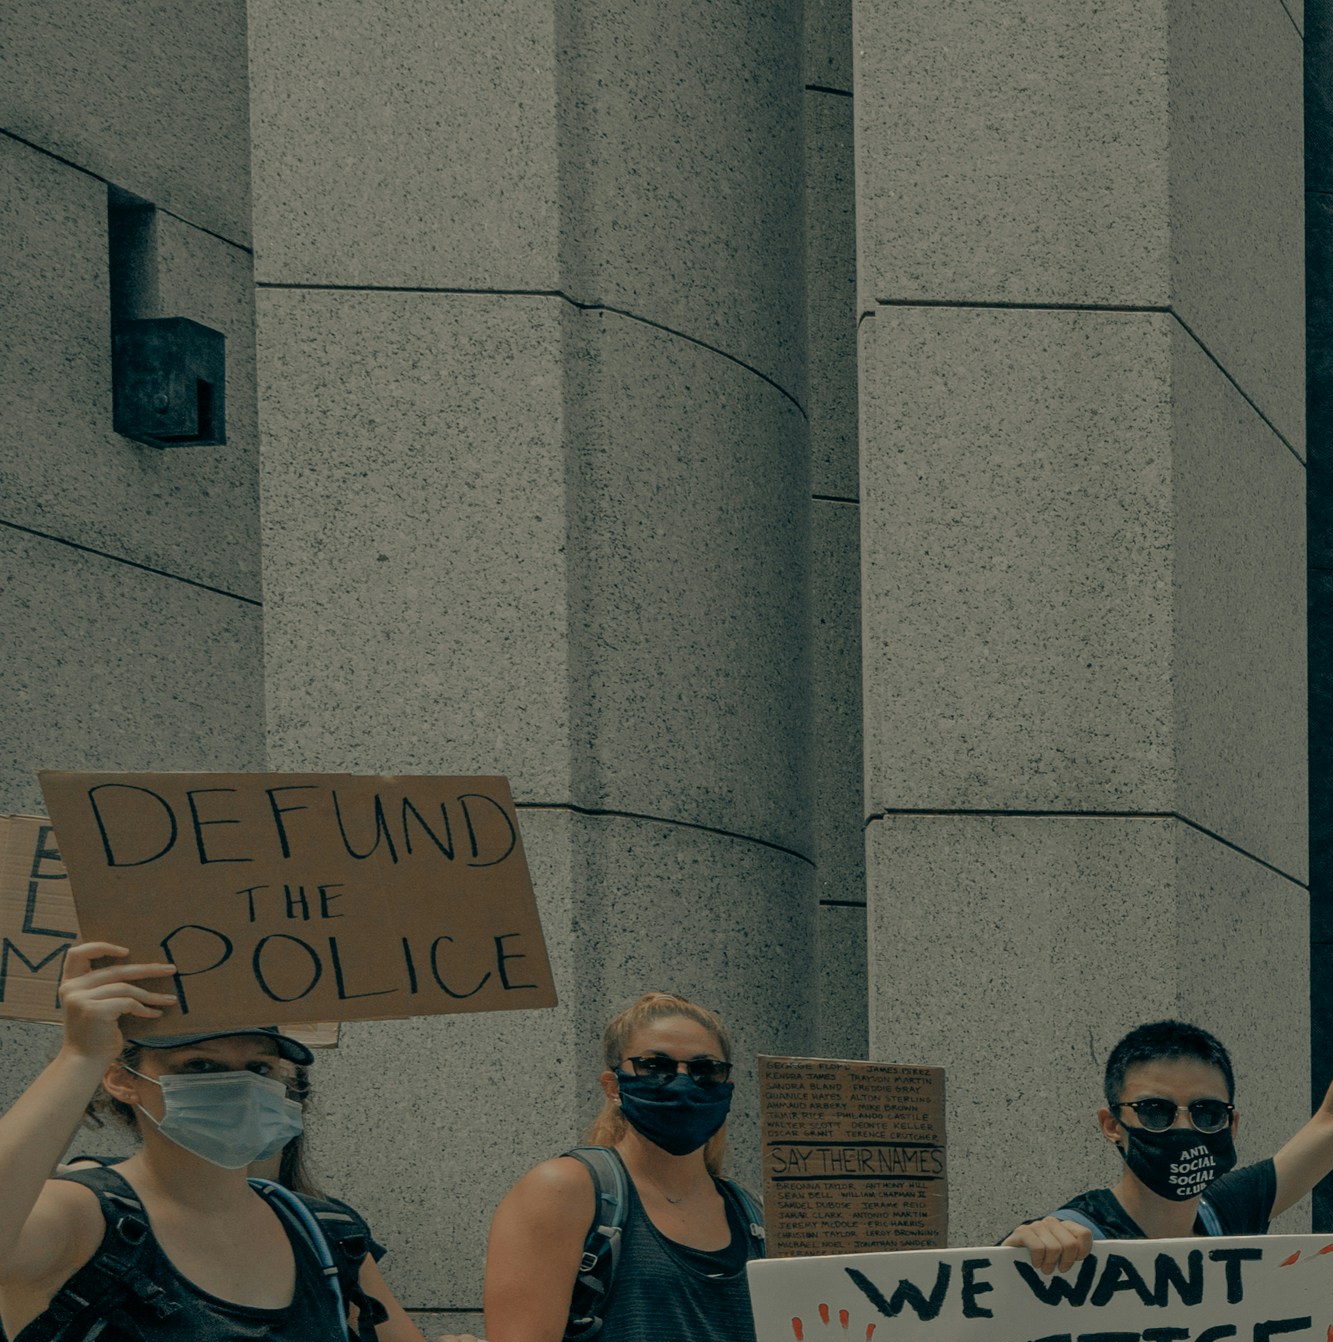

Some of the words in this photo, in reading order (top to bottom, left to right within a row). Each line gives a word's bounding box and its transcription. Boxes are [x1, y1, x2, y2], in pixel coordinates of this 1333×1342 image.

[89, 783, 518, 867] DEFUND
[236, 883, 345, 922] THE
[161, 925, 538, 1014] POLICE
[866, 1066, 897, 1074] JAMES
[902, 1068, 931, 1076] PEREZ
[766, 1072, 803, 1080] KENDRA
[806, 1073, 836, 1081] JAMES
[895, 1077, 932, 1085] MARTIN
[853, 1084, 892, 1093] FREDDIE
[895, 1085, 922, 1094] GRAY
[812, 1092, 842, 1100] HAYES
[767, 1102, 807, 1110] AHMAUD
[810, 1102, 848, 1110] ARBERY
[859, 1104, 881, 1112] MIKE
[884, 1104, 918, 1112] BROWN
[801, 1112, 824, 1120] RICE
[888, 1113, 929, 1121] CASTILE
[894, 1123, 934, 1131] KELLER
[845, 1130, 886, 1139] TERENCE
[1180, 1145, 1209, 1161] ANTI
[772, 1148, 813, 1173] SAY
[815, 1148, 875, 1173] THEIR
[879, 1147, 943, 1174] NAMES
[1170, 1155, 1216, 1173] SOCIAL
[1168, 1169, 1215, 1185] SOCIAL
[1176, 1182, 1207, 1195] CLUB
[903, 1201, 926, 1209] REID
[844, 1258, 994, 1321] WE
[1013, 1248, 1262, 1306] WANT
